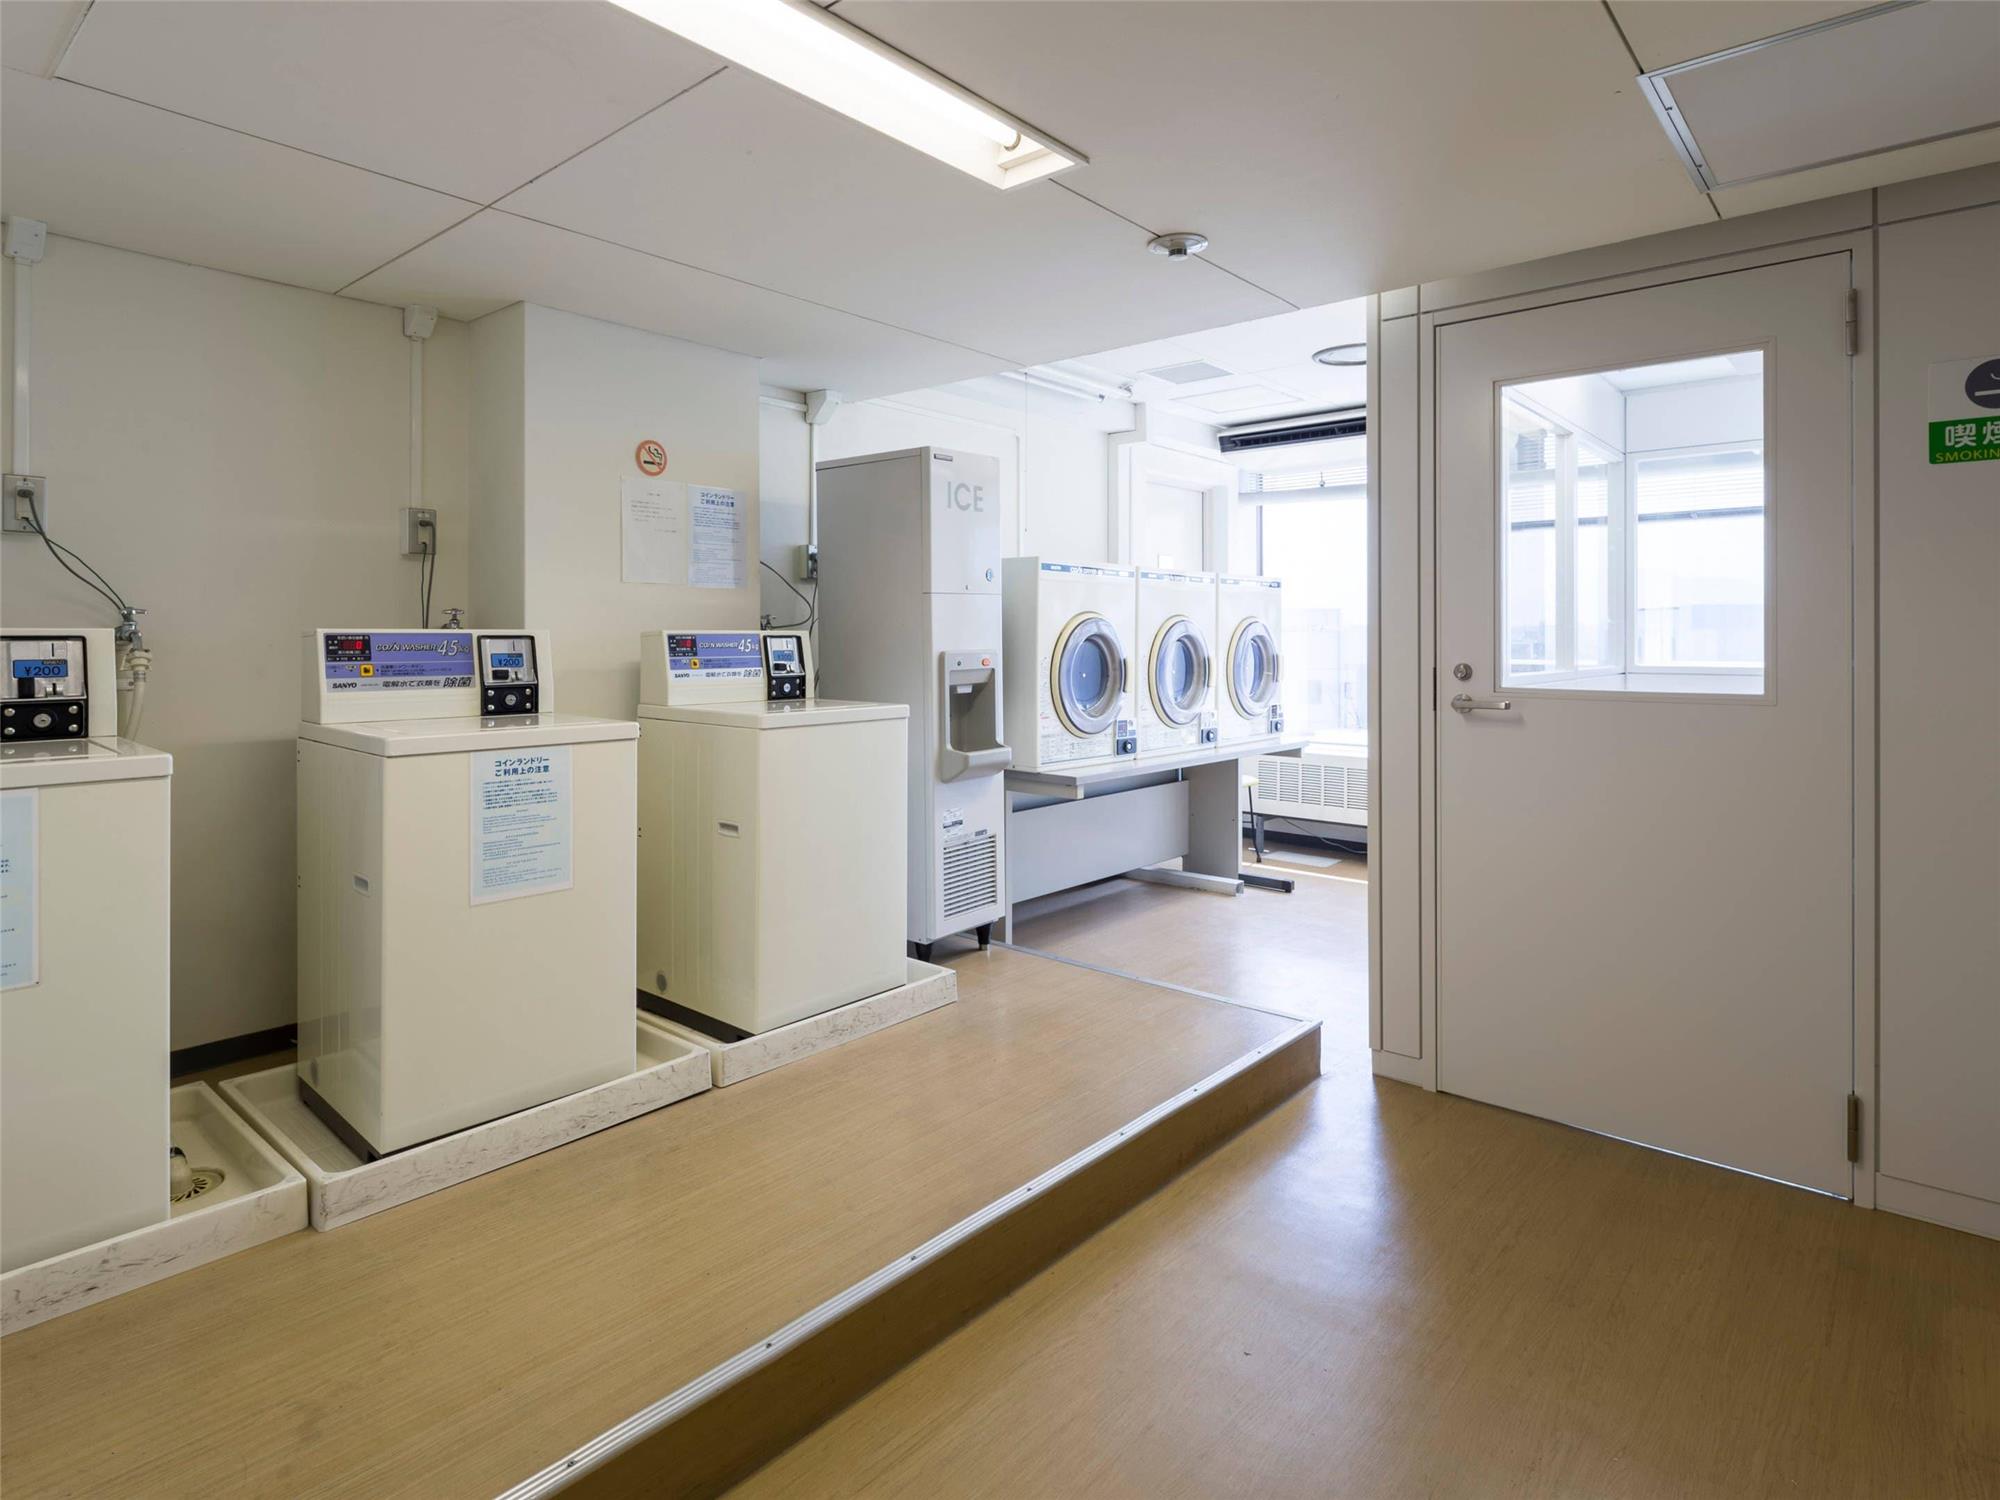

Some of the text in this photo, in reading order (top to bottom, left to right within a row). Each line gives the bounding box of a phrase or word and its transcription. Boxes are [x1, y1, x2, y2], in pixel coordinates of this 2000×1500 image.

[1945, 421, 2000, 448] 喫煙
[1935, 448, 2000, 463] SMOKIN
[947, 480, 984, 513] ICE
[402, 642, 438, 652] WASHER
[495, 756, 550, 767] コインランドリー
[495, 765, 550, 777] ご利用上の注意
